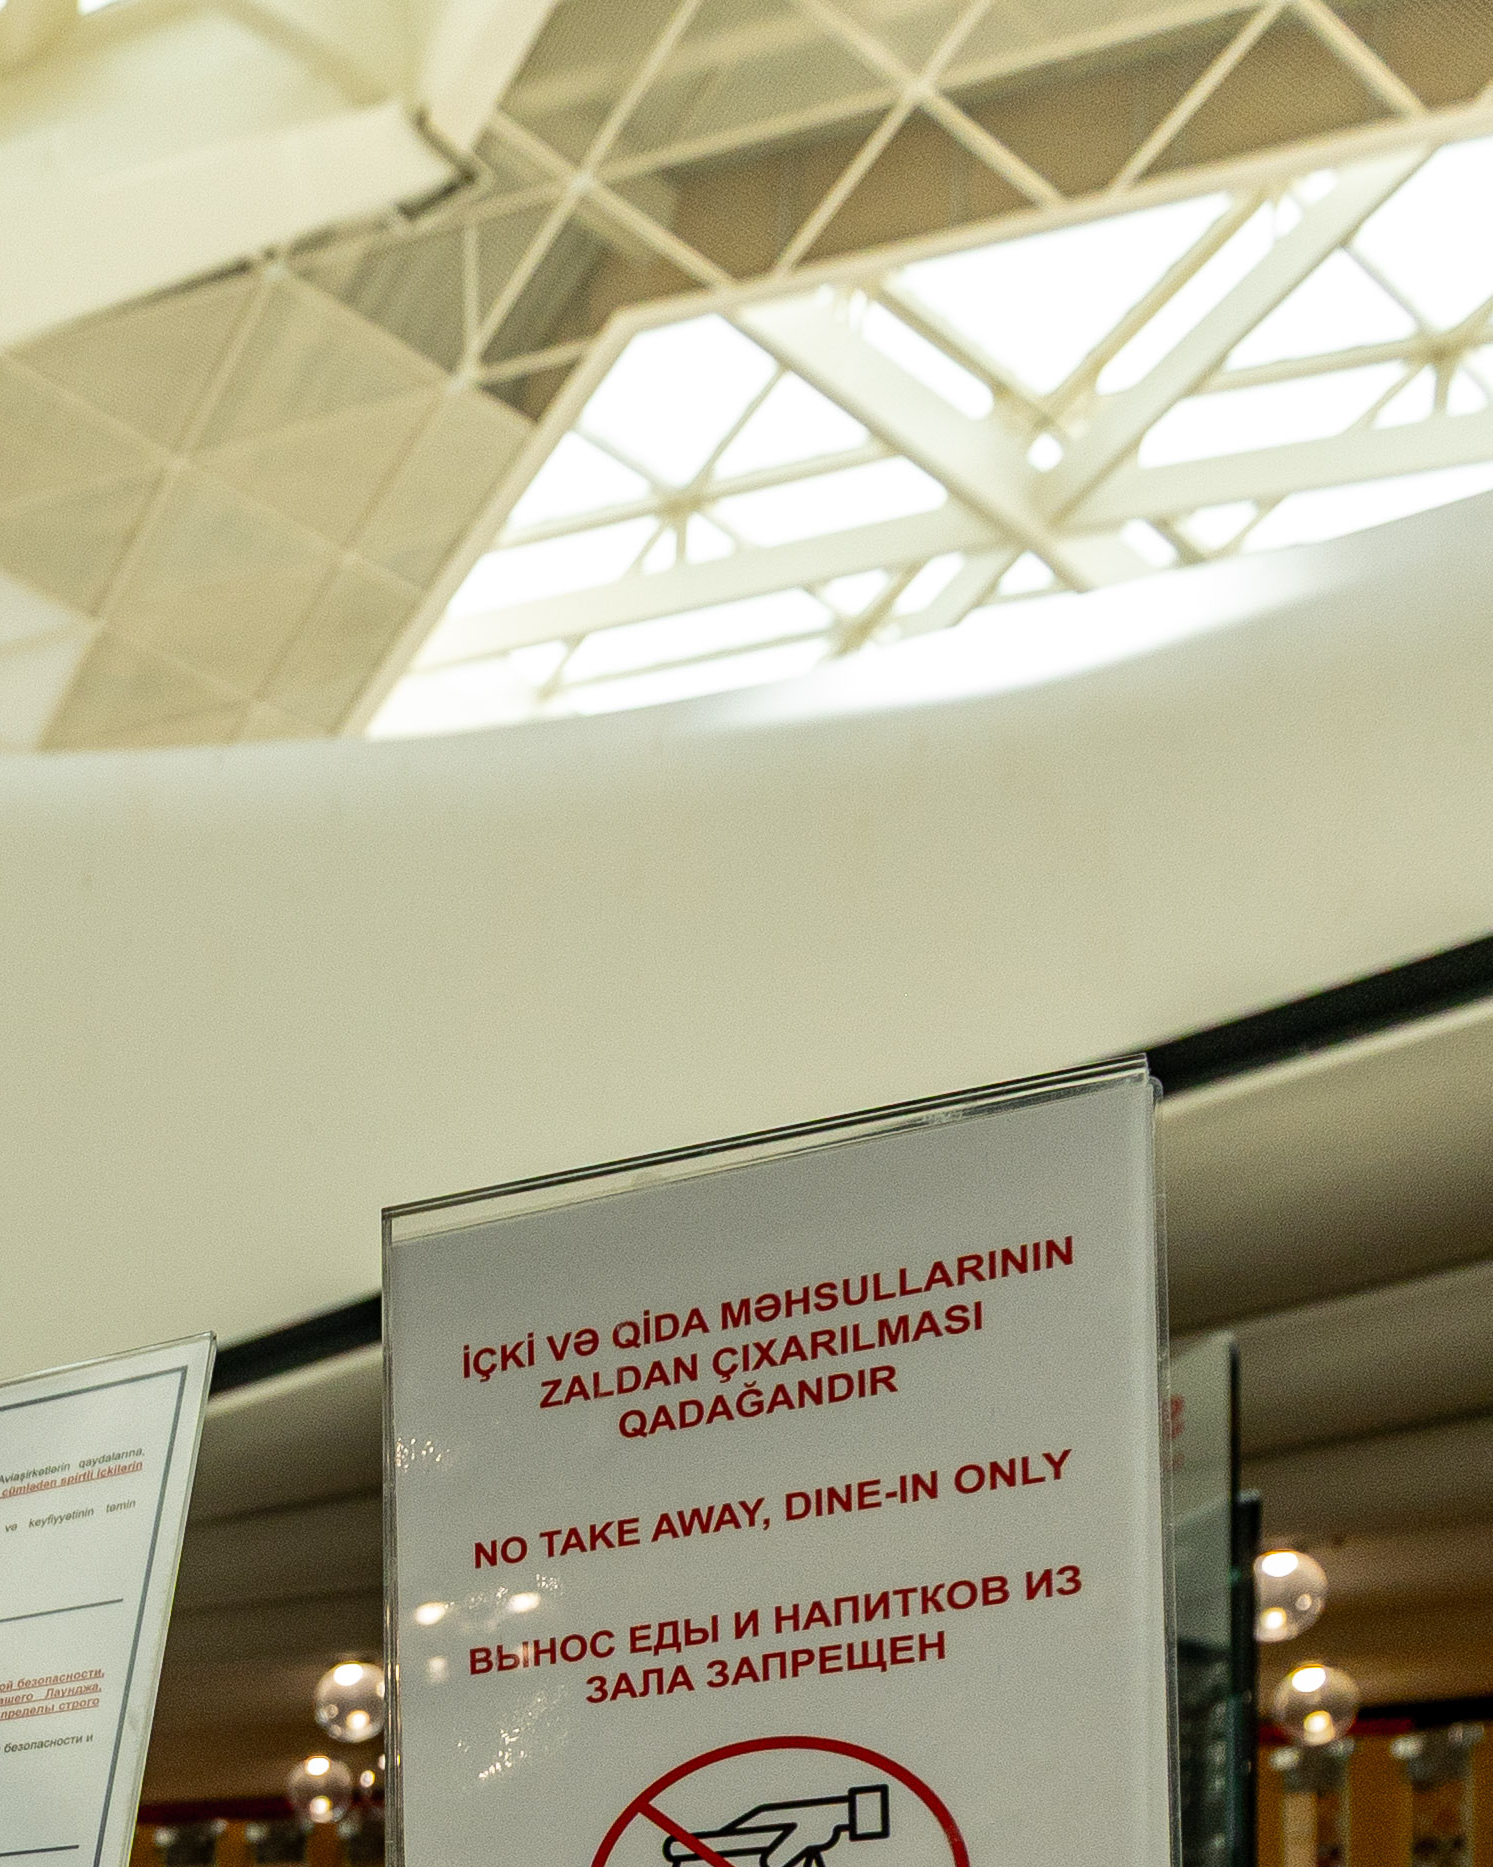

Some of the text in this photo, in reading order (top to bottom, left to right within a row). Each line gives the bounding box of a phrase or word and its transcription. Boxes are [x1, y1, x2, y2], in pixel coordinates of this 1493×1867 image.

[463, 1236, 1071, 1380] İÇKİ VƏ QİDA MƏHSULLARININ
[540, 1301, 981, 1408] ZALDAN ÇIXARILMASI
[618, 1365, 896, 1437] QADAĞANDIR
[474, 1449, 1069, 1567] NO TAKE AWAY, DINE-IN ONLY
[469, 1565, 1080, 1674] ВЫНОС ЕДЫ И НАПИТКОВ ИЗ
[587, 1632, 944, 1702] ЗАЛА ЗАПРЕЩЕН
